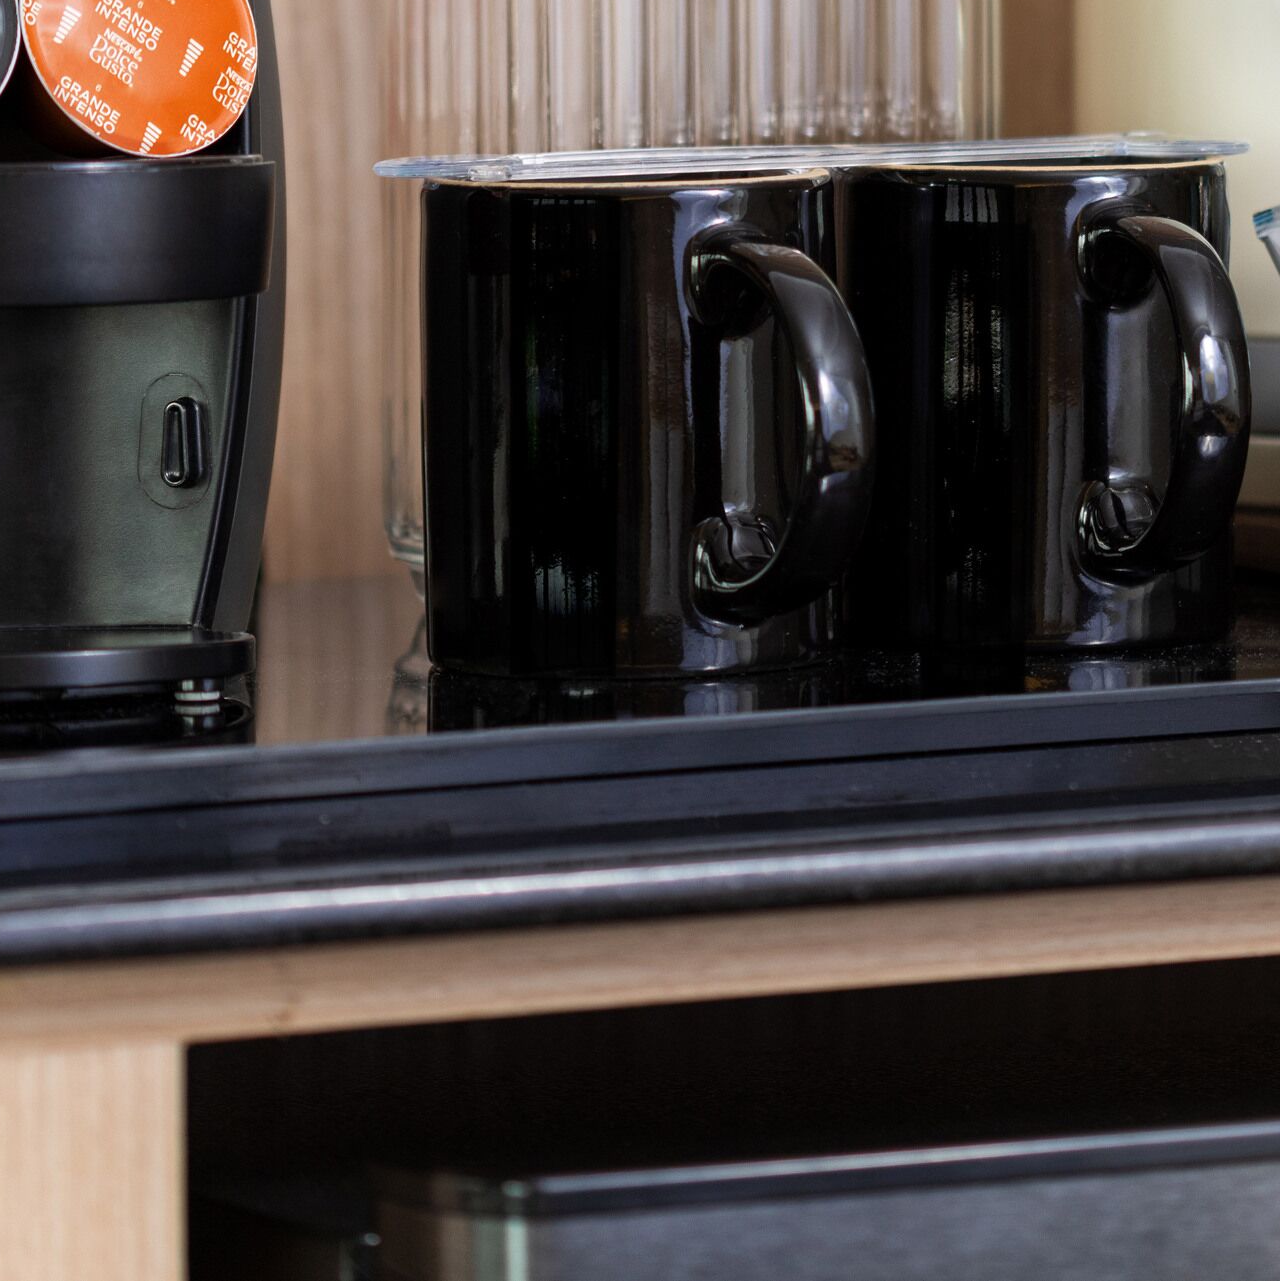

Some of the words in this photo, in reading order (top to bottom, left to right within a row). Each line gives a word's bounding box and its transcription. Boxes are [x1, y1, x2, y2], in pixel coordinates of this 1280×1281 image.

[94, 0, 157, 51] INTENSO
[89, 47, 133, 85] Gusto
[93, 33, 138, 75] Dolce
[52, 84, 116, 134] INTENSO
[59, 75, 121, 125] GRANDE
